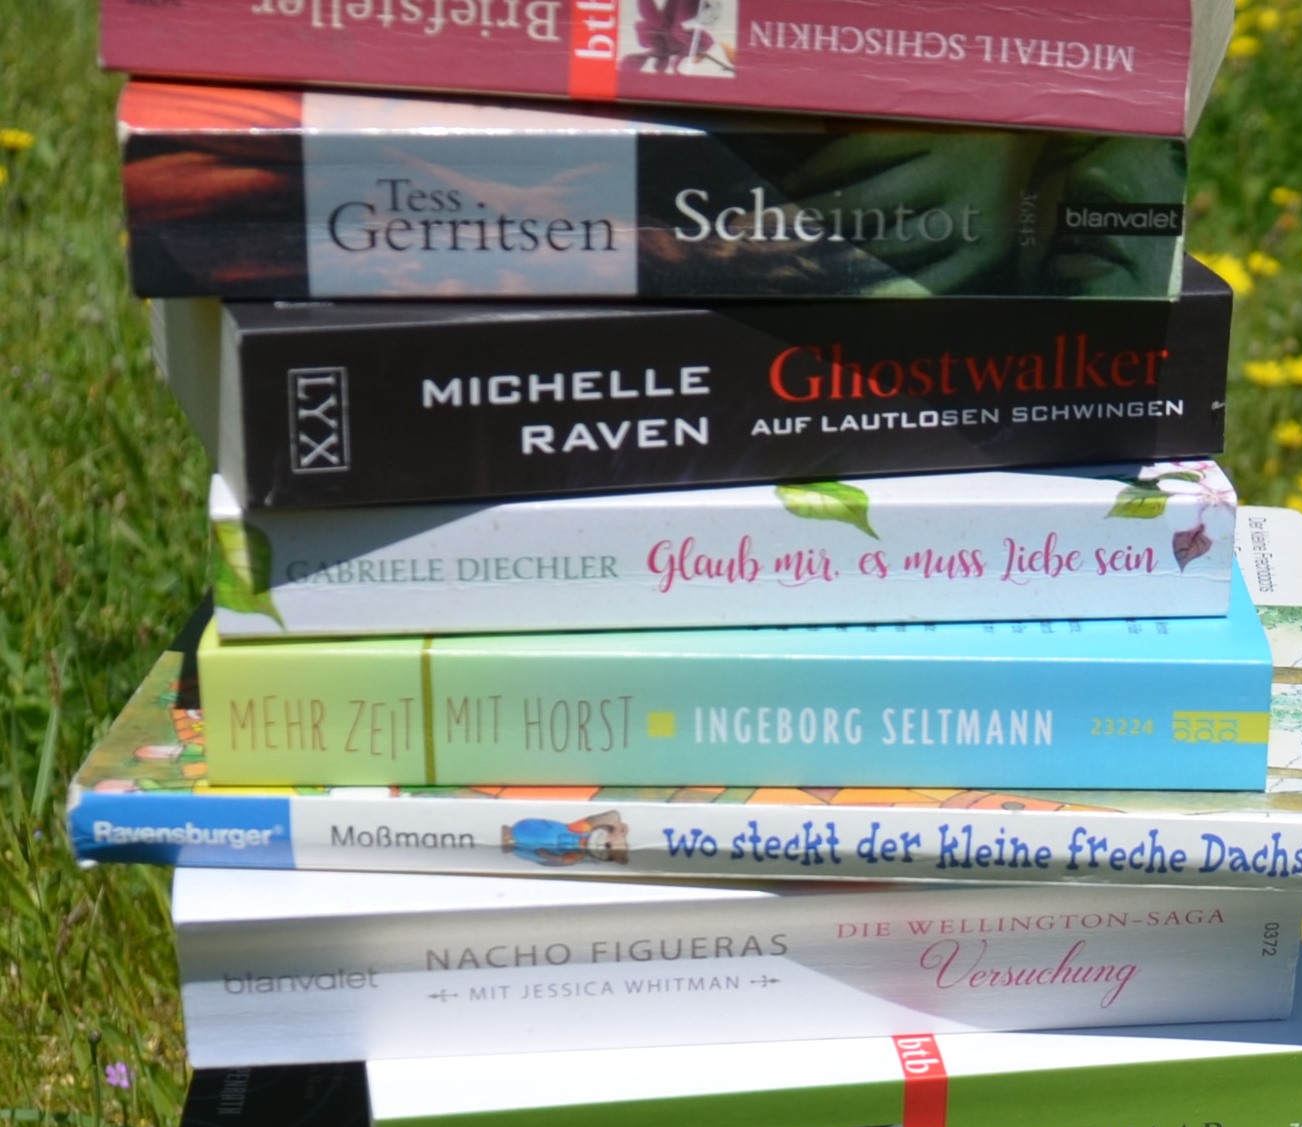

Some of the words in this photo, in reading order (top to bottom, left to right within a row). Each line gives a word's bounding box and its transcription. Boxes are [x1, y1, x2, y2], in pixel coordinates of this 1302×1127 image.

[575, 0, 616, 59] bt
[749, 20, 966, 60] SCHISCHKIN
[984, 35, 1134, 72] MICHAIL
[376, 179, 462, 212] Tess
[674, 187, 981, 242] Scheintot
[328, 202, 617, 253] Gerritsen
[1066, 207, 1177, 229] blanvalet
[769, 332, 1169, 401] Ghostwalker
[422, 366, 710, 408] MICHELLE
[299, 375, 338, 466] LYX
[522, 417, 709, 454] RAVEN
[750, 418, 810, 436] AUF
[821, 408, 999, 433] LAUTLOSEN
[1012, 400, 1183, 424] SCHWINGEN
[286, 557, 444, 586] GABRIELE
[458, 554, 619, 583] DIECHLER
[646, 534, 762, 593] Glaub
[858, 551, 889, 579] es
[904, 546, 986, 577] muss
[1000, 532, 1083, 585] Liebe
[1094, 546, 1159, 576] sein
[230, 695, 328, 752] MEHR
[344, 698, 414, 760] ZEIT
[446, 695, 502, 745] MIT
[523, 695, 633, 752] HORST
[694, 707, 864, 745] INGEBORG
[882, 709, 1053, 746] SELTMANN
[1089, 717, 1154, 735] 23224
[330, 825, 475, 849] Moßmann
[730, 821, 842, 865] steckt
[857, 824, 921, 862] der
[937, 825, 1051, 869] kleine
[1067, 827, 1187, 874] freche
[836, 922, 891, 938] DIE
[908, 908, 1225, 937] WELLINGTON-SAGA
[1262, 922, 1278, 956] 0372
[426, 943, 572, 972] NACHO
[591, 933, 787, 964] FIGUERAS
[223, 967, 379, 995] blanvalet
[469, 983, 510, 1001] MIT
[521, 980, 615, 999] JESSICA
[625, 975, 740, 995] WHITMAN
[919, 939, 1141, 1009] Versuchung
[896, 1036, 932, 1074] btb
